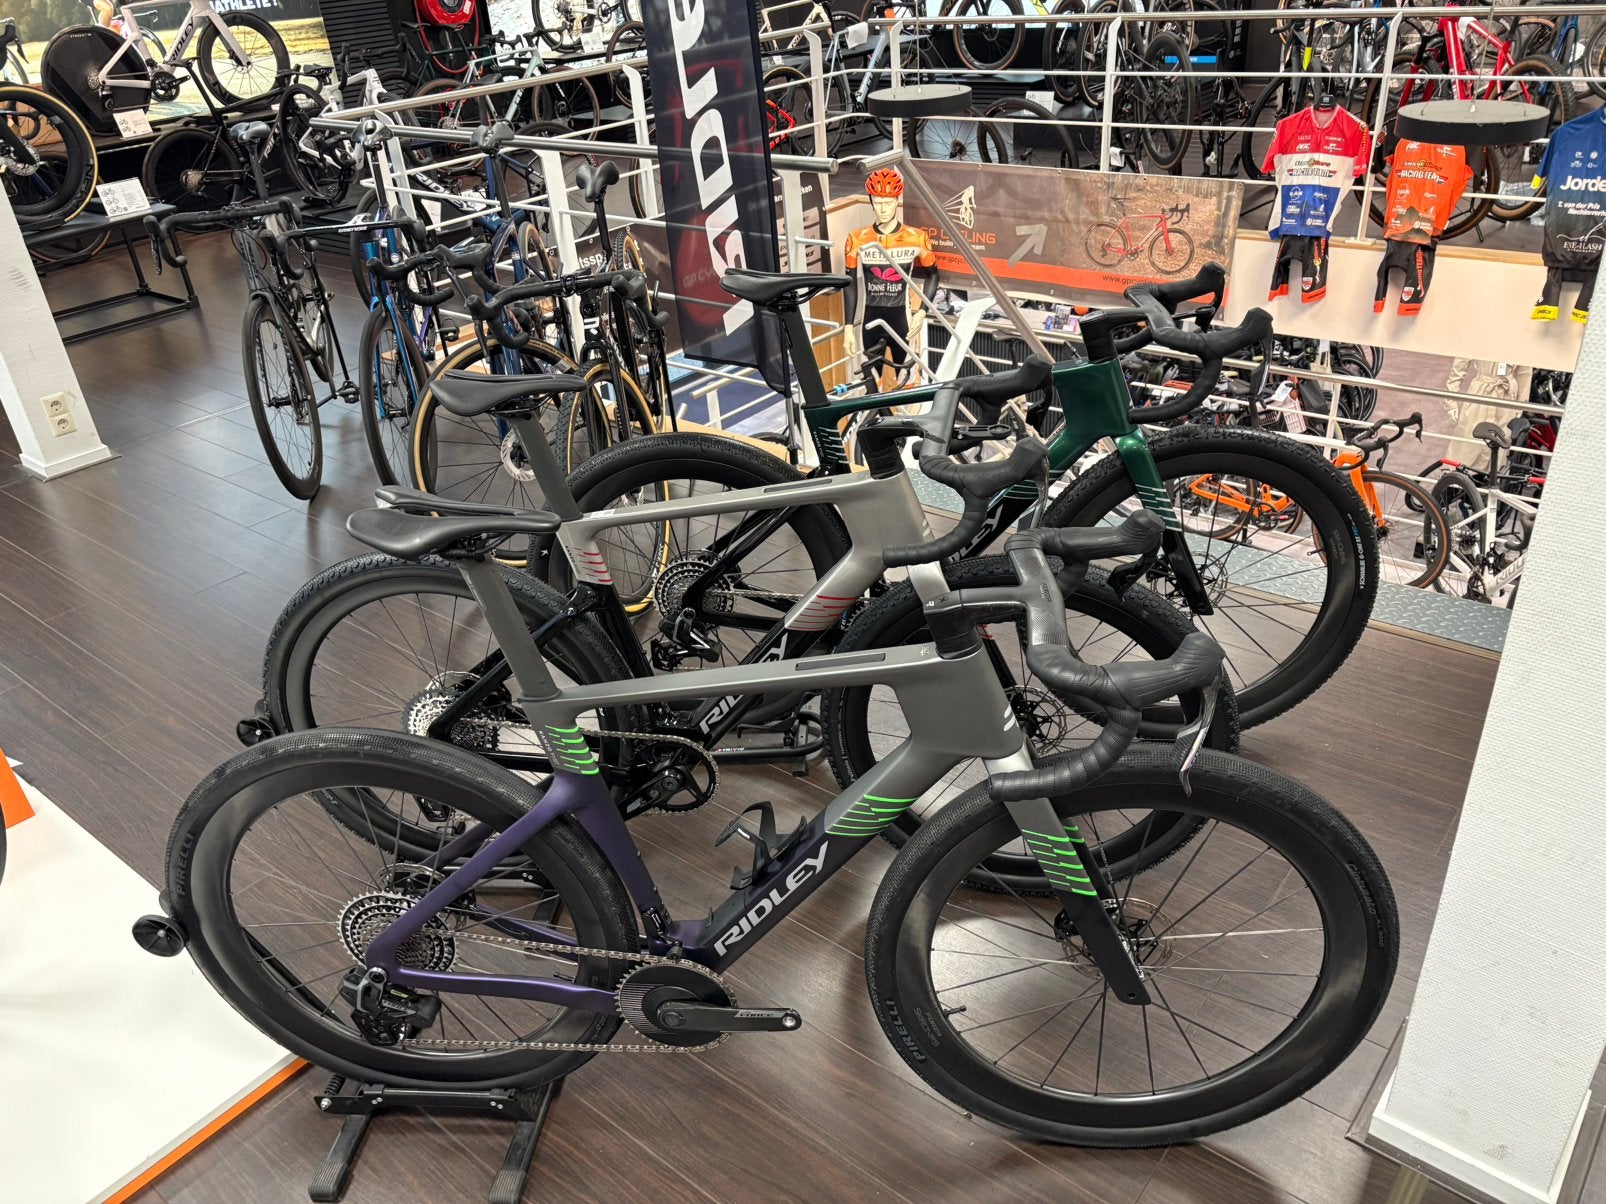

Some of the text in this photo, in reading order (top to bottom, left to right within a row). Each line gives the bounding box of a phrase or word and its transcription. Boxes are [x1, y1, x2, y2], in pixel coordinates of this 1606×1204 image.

[539, 730, 553, 752] KANZO
[176, 833, 195, 896] PIRELLI
[713, 840, 829, 957] RIDLEY
[885, 1000, 926, 1060] PIRELLI
